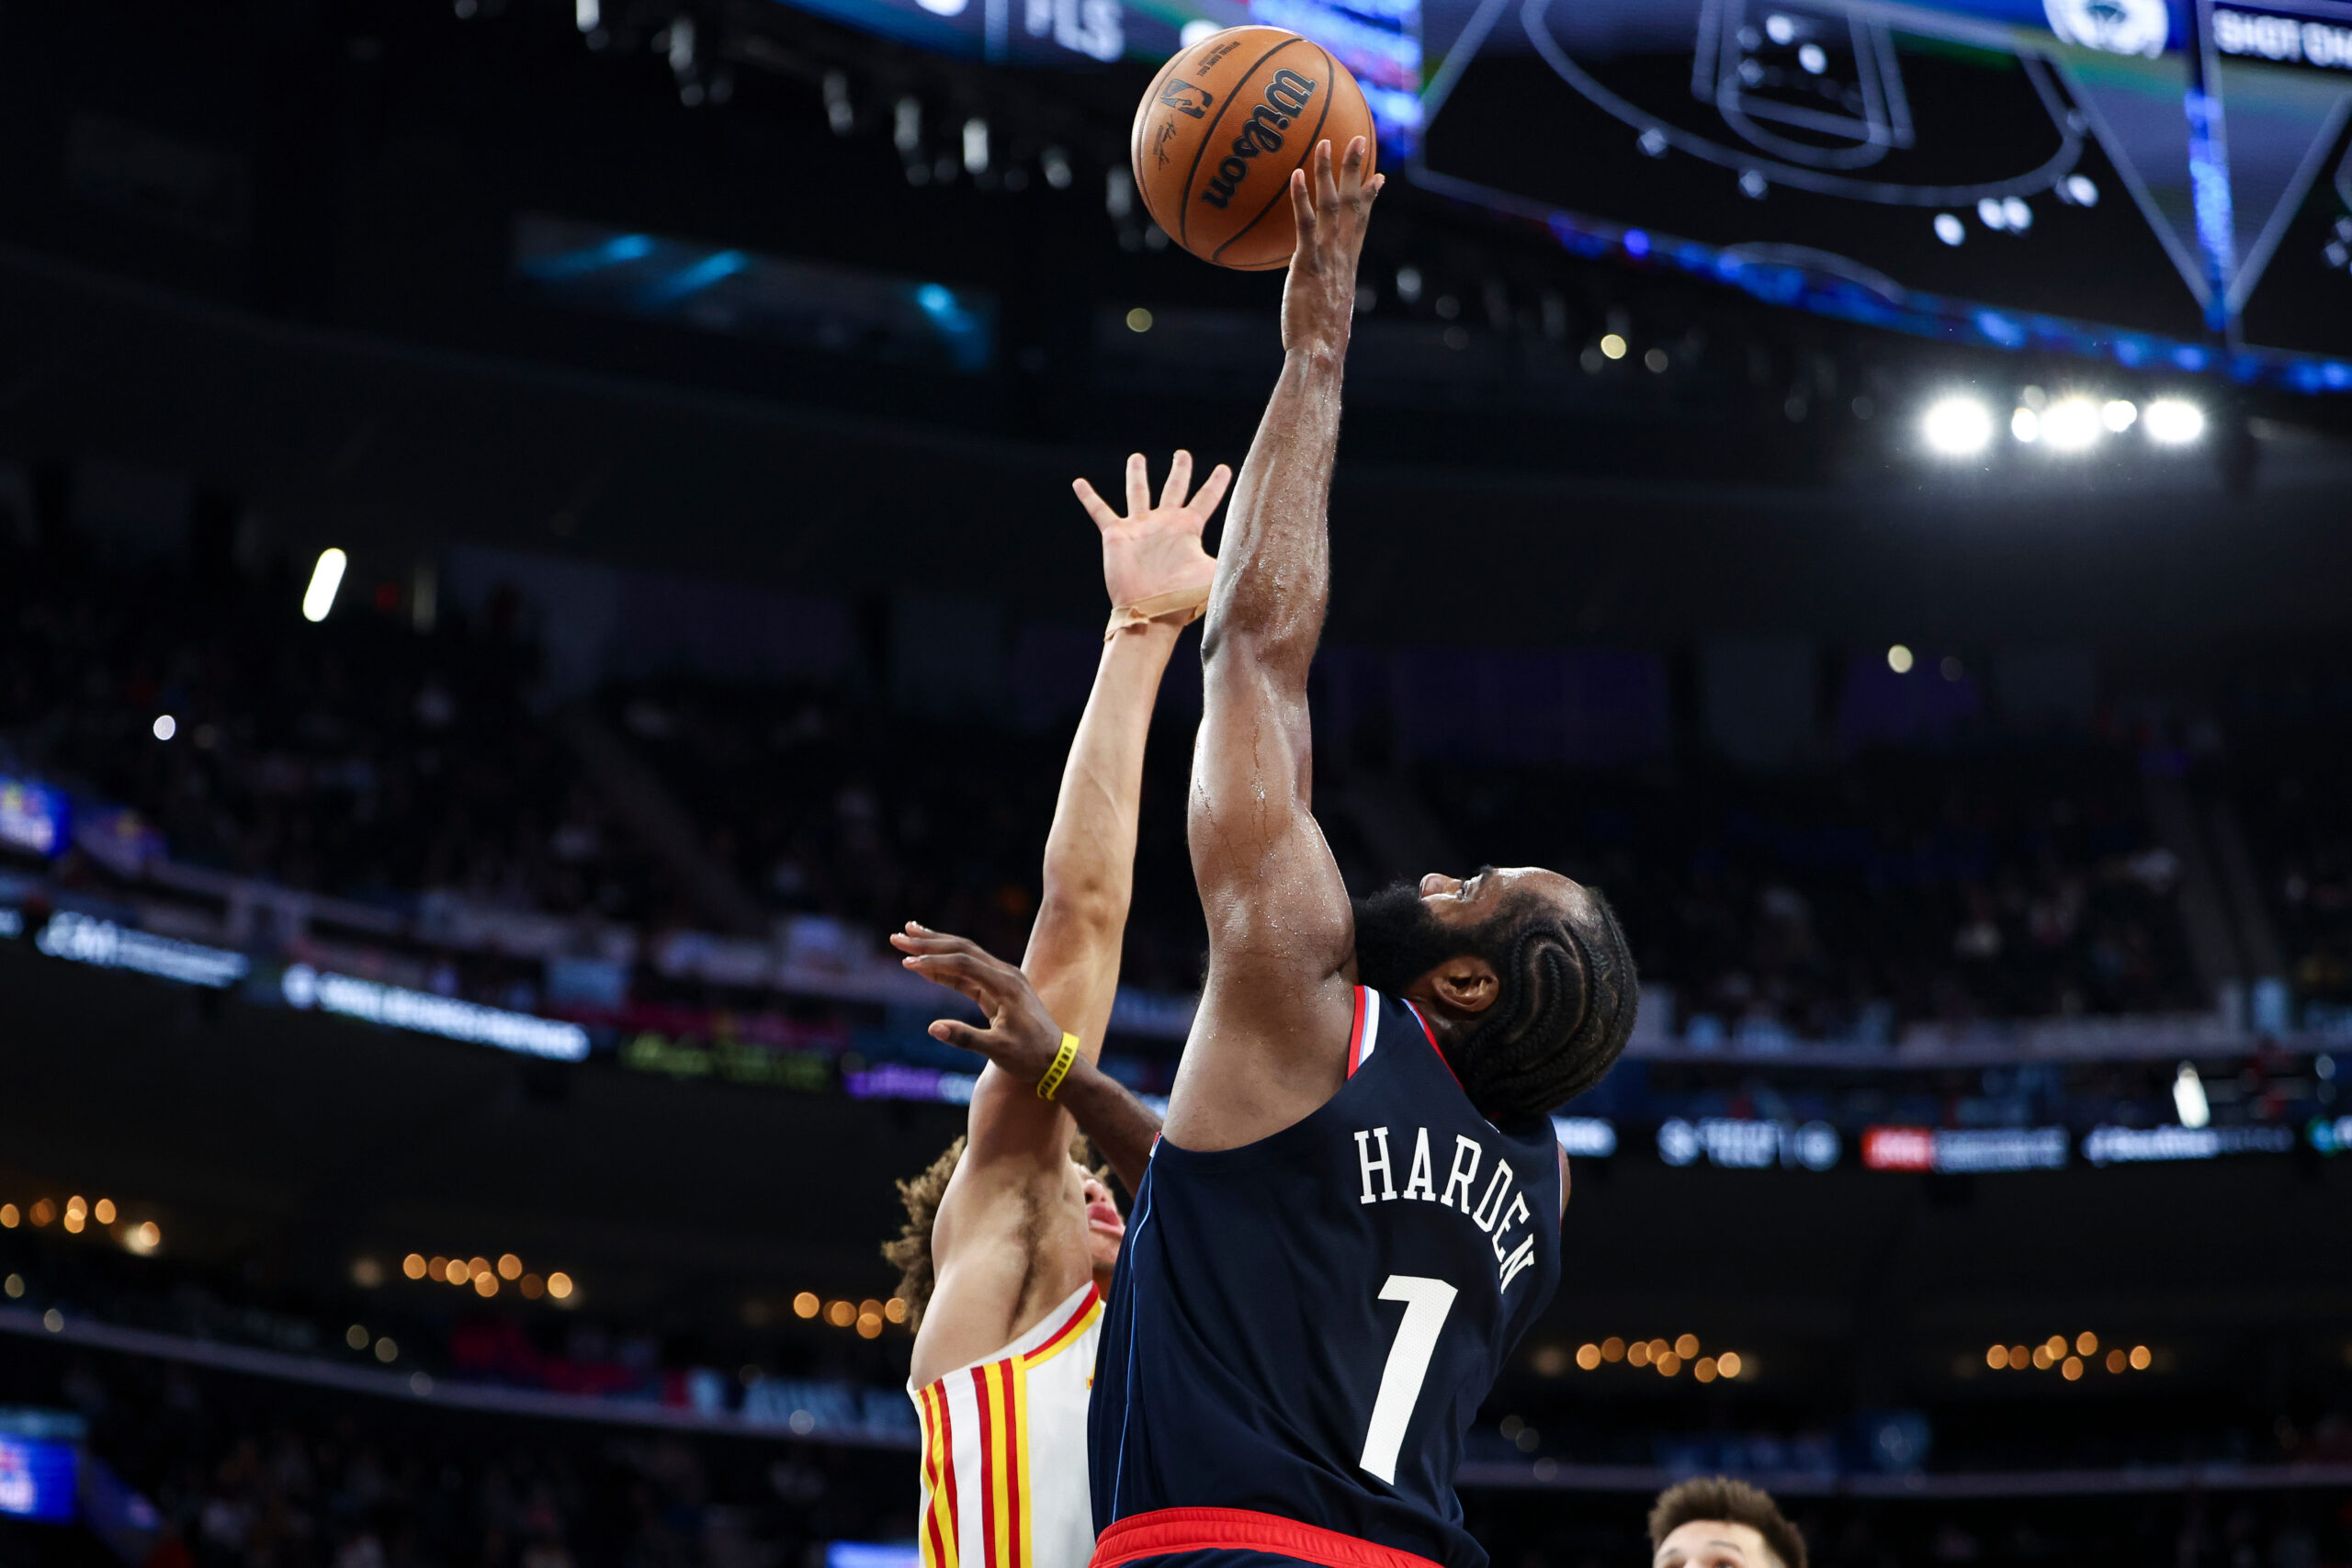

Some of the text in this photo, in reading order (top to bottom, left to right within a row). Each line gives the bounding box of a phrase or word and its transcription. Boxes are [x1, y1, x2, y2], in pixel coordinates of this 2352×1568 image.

[1201, 69, 1317, 209] Wilson
[1354, 1126, 1534, 1295] HARDEN
[1360, 1274, 1458, 1485] 1
